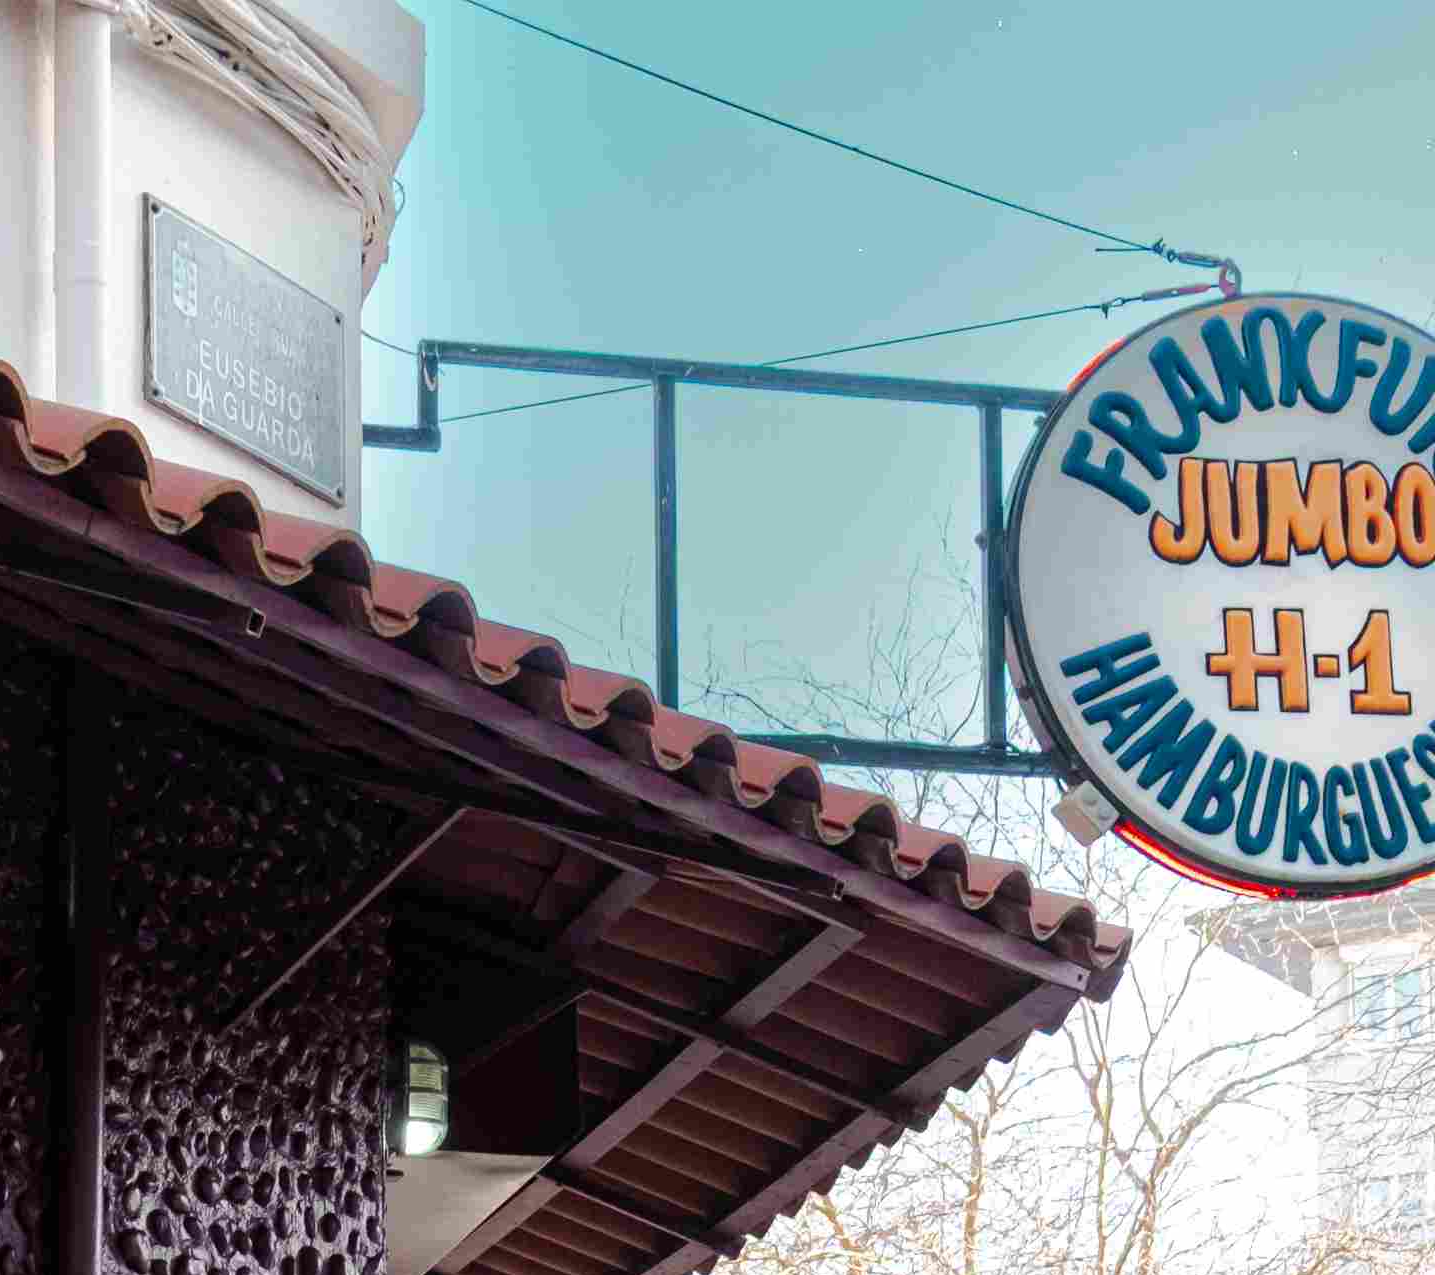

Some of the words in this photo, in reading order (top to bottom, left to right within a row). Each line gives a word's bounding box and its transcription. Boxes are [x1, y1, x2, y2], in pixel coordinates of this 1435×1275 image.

[186, 368, 216, 411] DA
[223, 391, 317, 470] GUARDA
[199, 338, 303, 421] EUSEBIO
[1205, 607, 1412, 716] H-1
